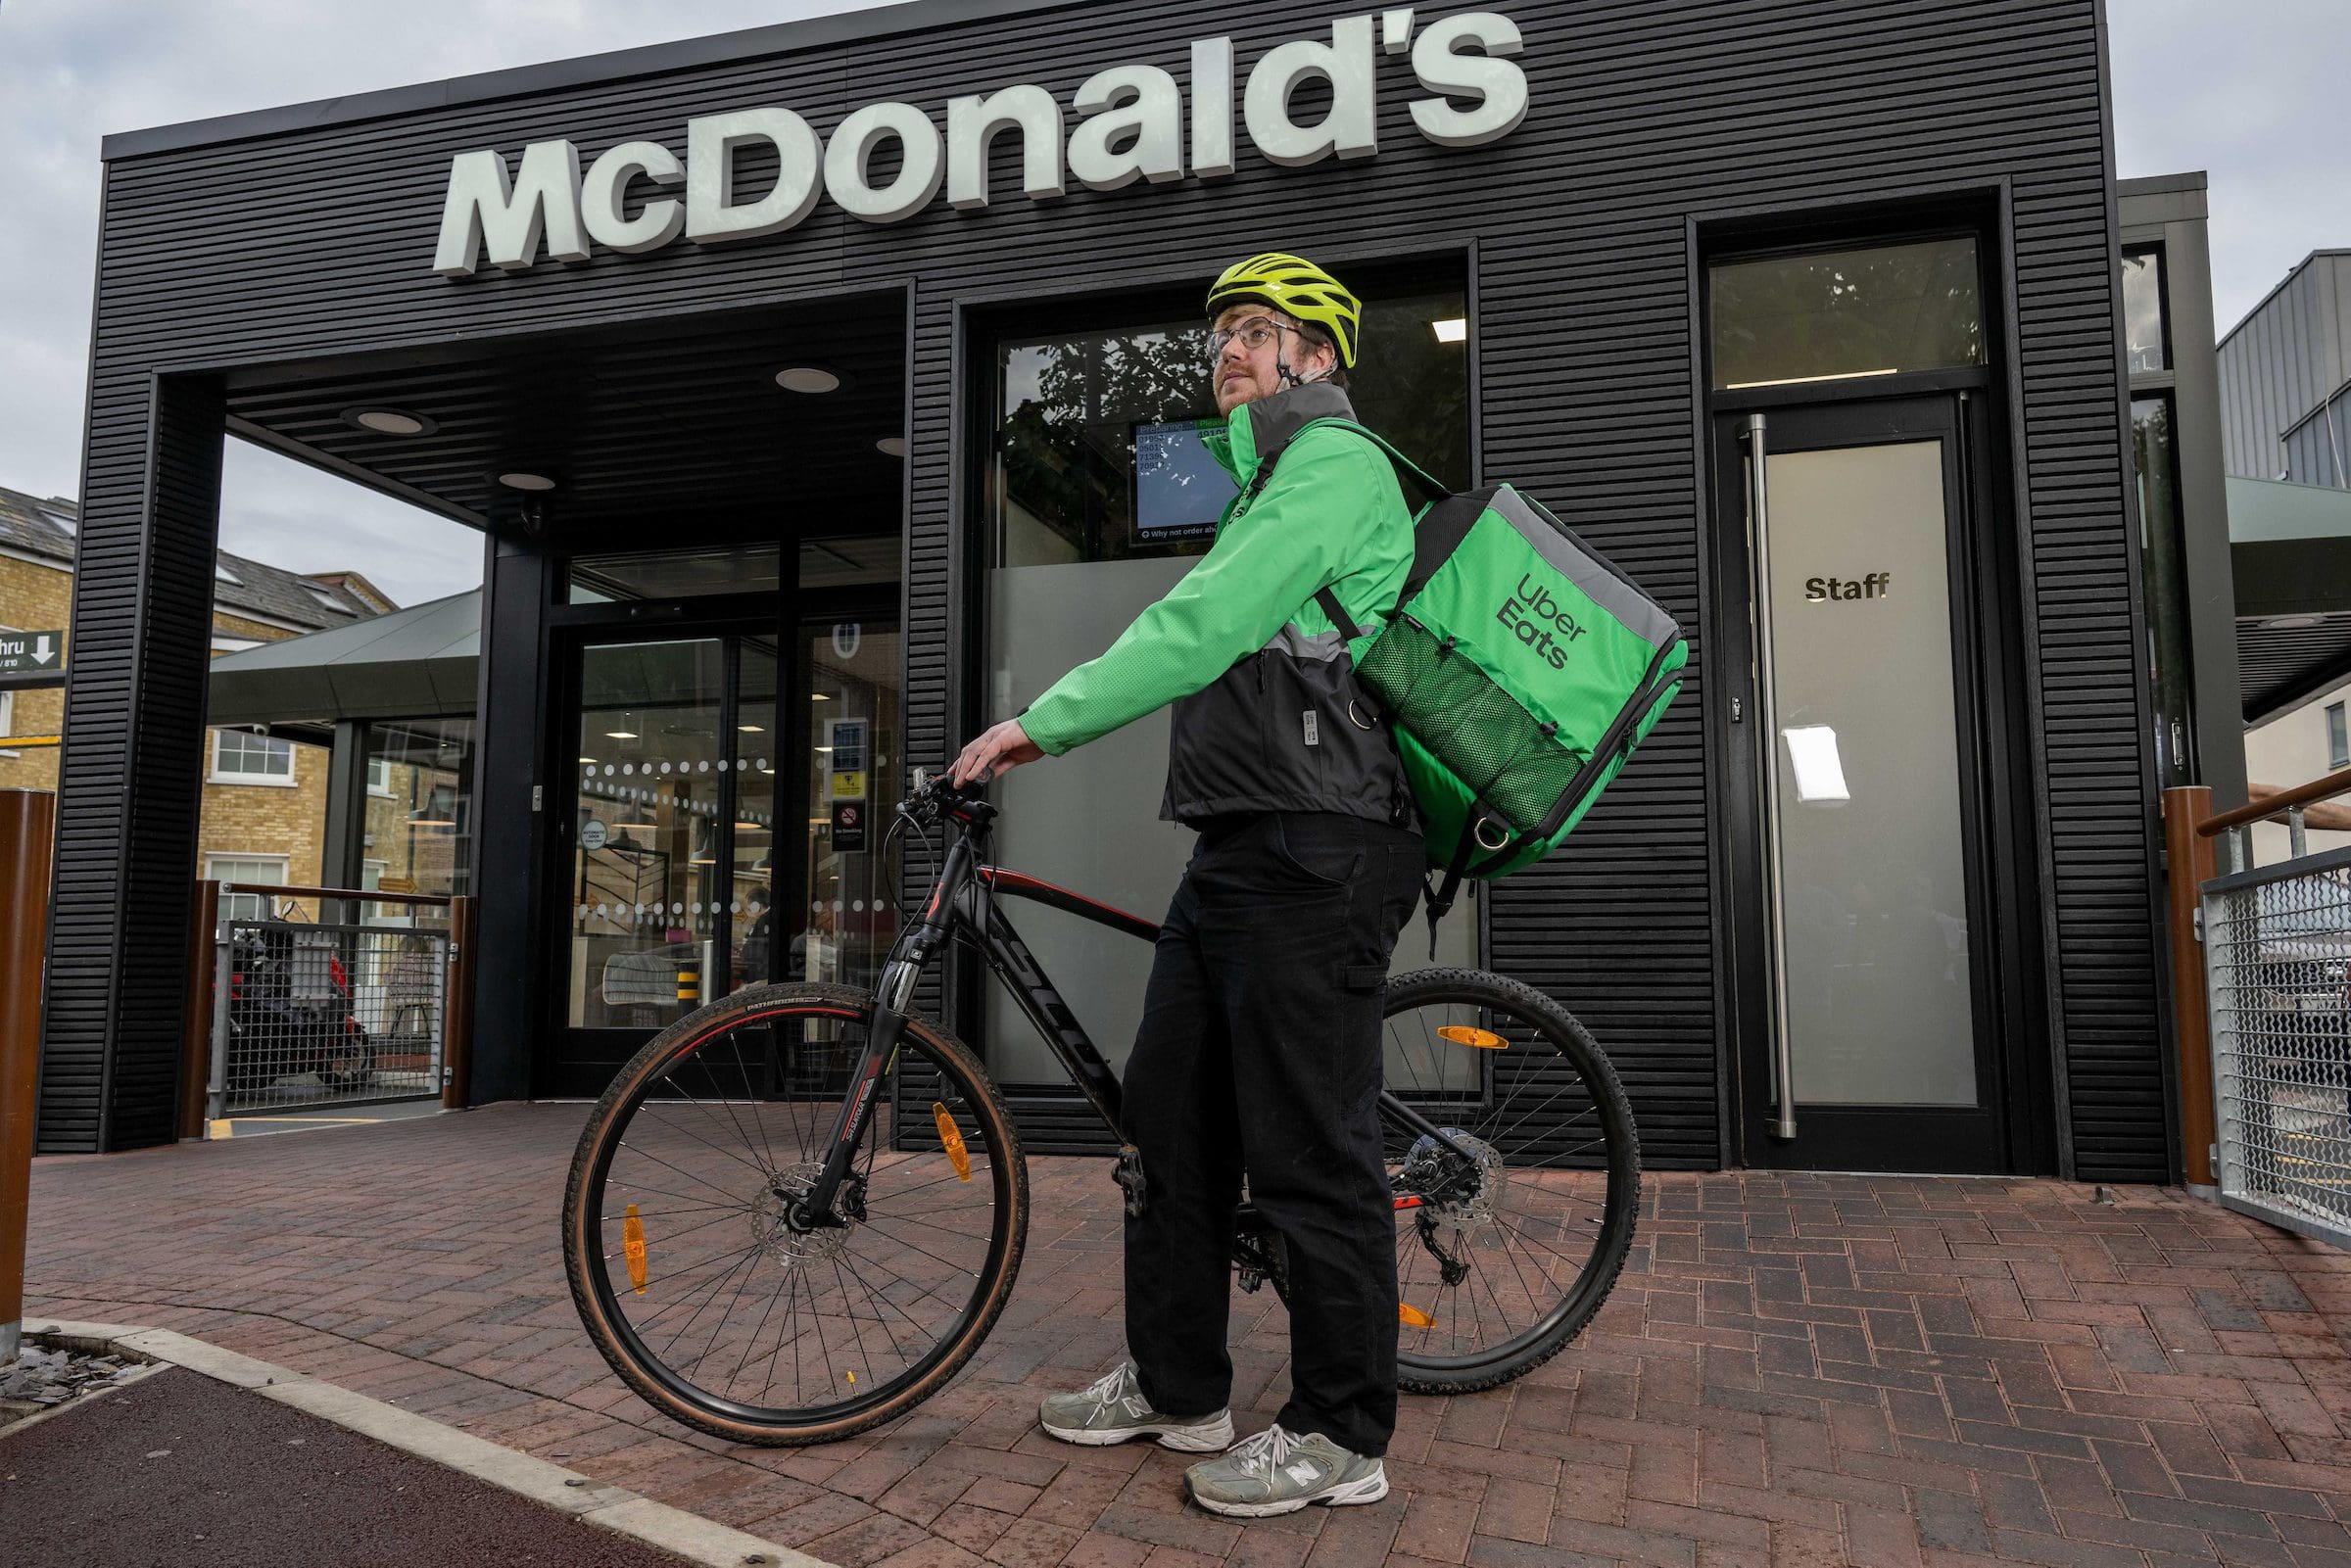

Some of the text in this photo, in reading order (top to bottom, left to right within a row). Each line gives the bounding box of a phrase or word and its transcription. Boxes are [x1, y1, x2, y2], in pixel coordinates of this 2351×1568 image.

[432, 9, 1529, 277] McDonald's
[1151, 530, 1168, 539] Why
[1517, 573, 1587, 641] Uber
[1805, 572, 1890, 602] Staff
[1497, 596, 1568, 670] Eats
